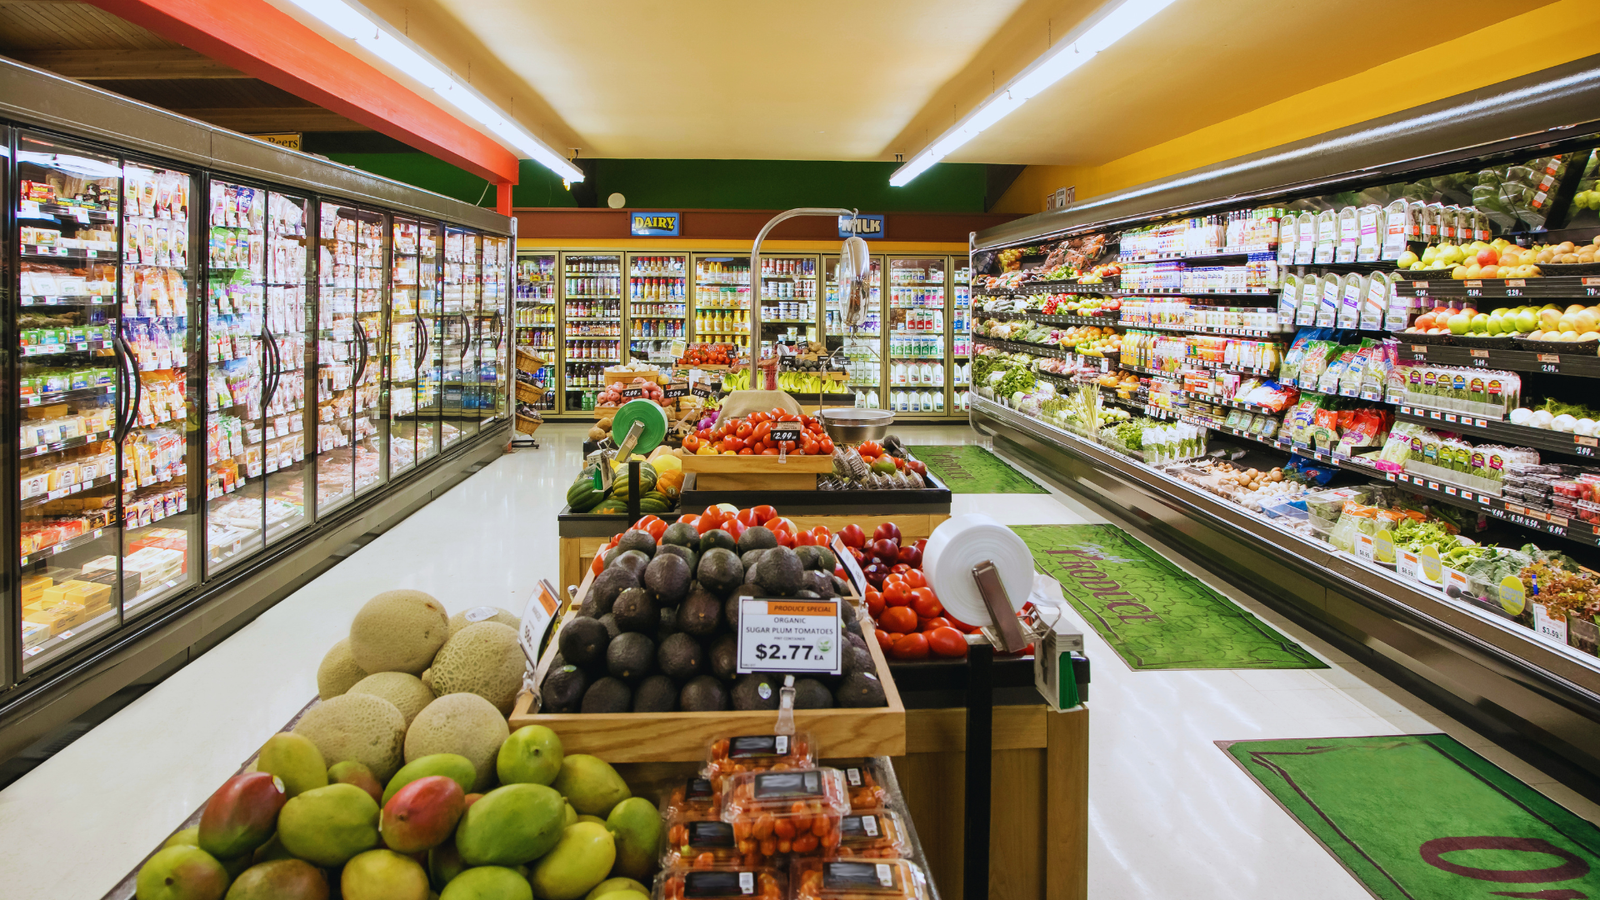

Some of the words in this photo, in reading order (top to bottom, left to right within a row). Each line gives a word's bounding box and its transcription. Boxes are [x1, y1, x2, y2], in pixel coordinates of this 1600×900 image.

[634, 216, 676, 231] DAIRY
[842, 218, 881, 233] MILK
[1046, 550, 1168, 624] PRODUCE
[1501, 592, 1523, 606] LOCAL
[755, 643, 814, 661] $2.77
